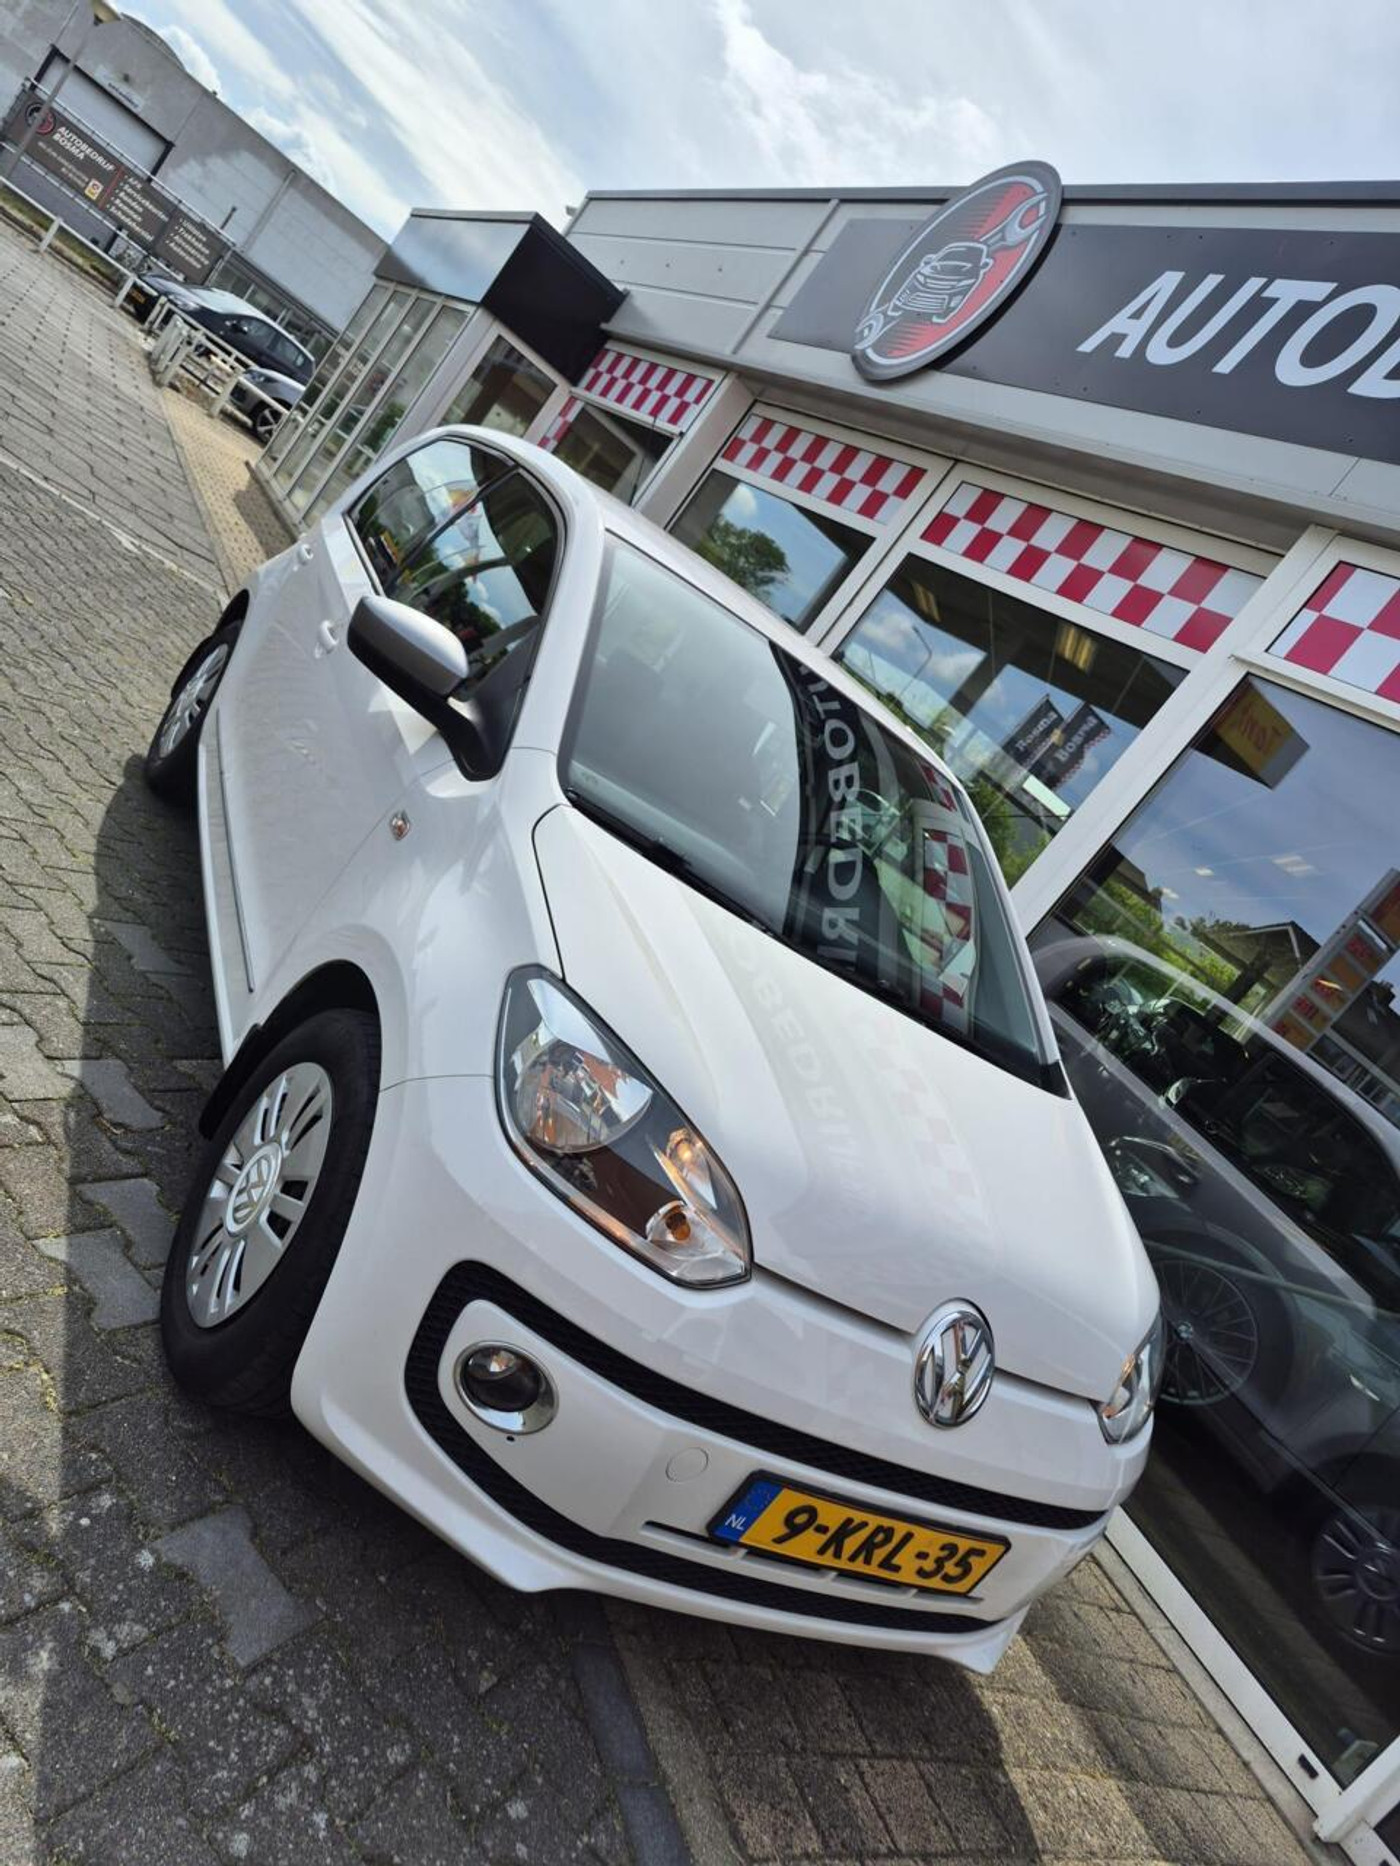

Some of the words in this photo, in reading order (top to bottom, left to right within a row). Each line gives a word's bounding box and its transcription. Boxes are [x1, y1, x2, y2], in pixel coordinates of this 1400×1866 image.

[52, 133, 86, 160] BOSMA
[57, 126, 115, 171] AUTOBEDRIJF
[724, 1513, 747, 1531] NL
[771, 1504, 986, 1584] 9-KRL-35
